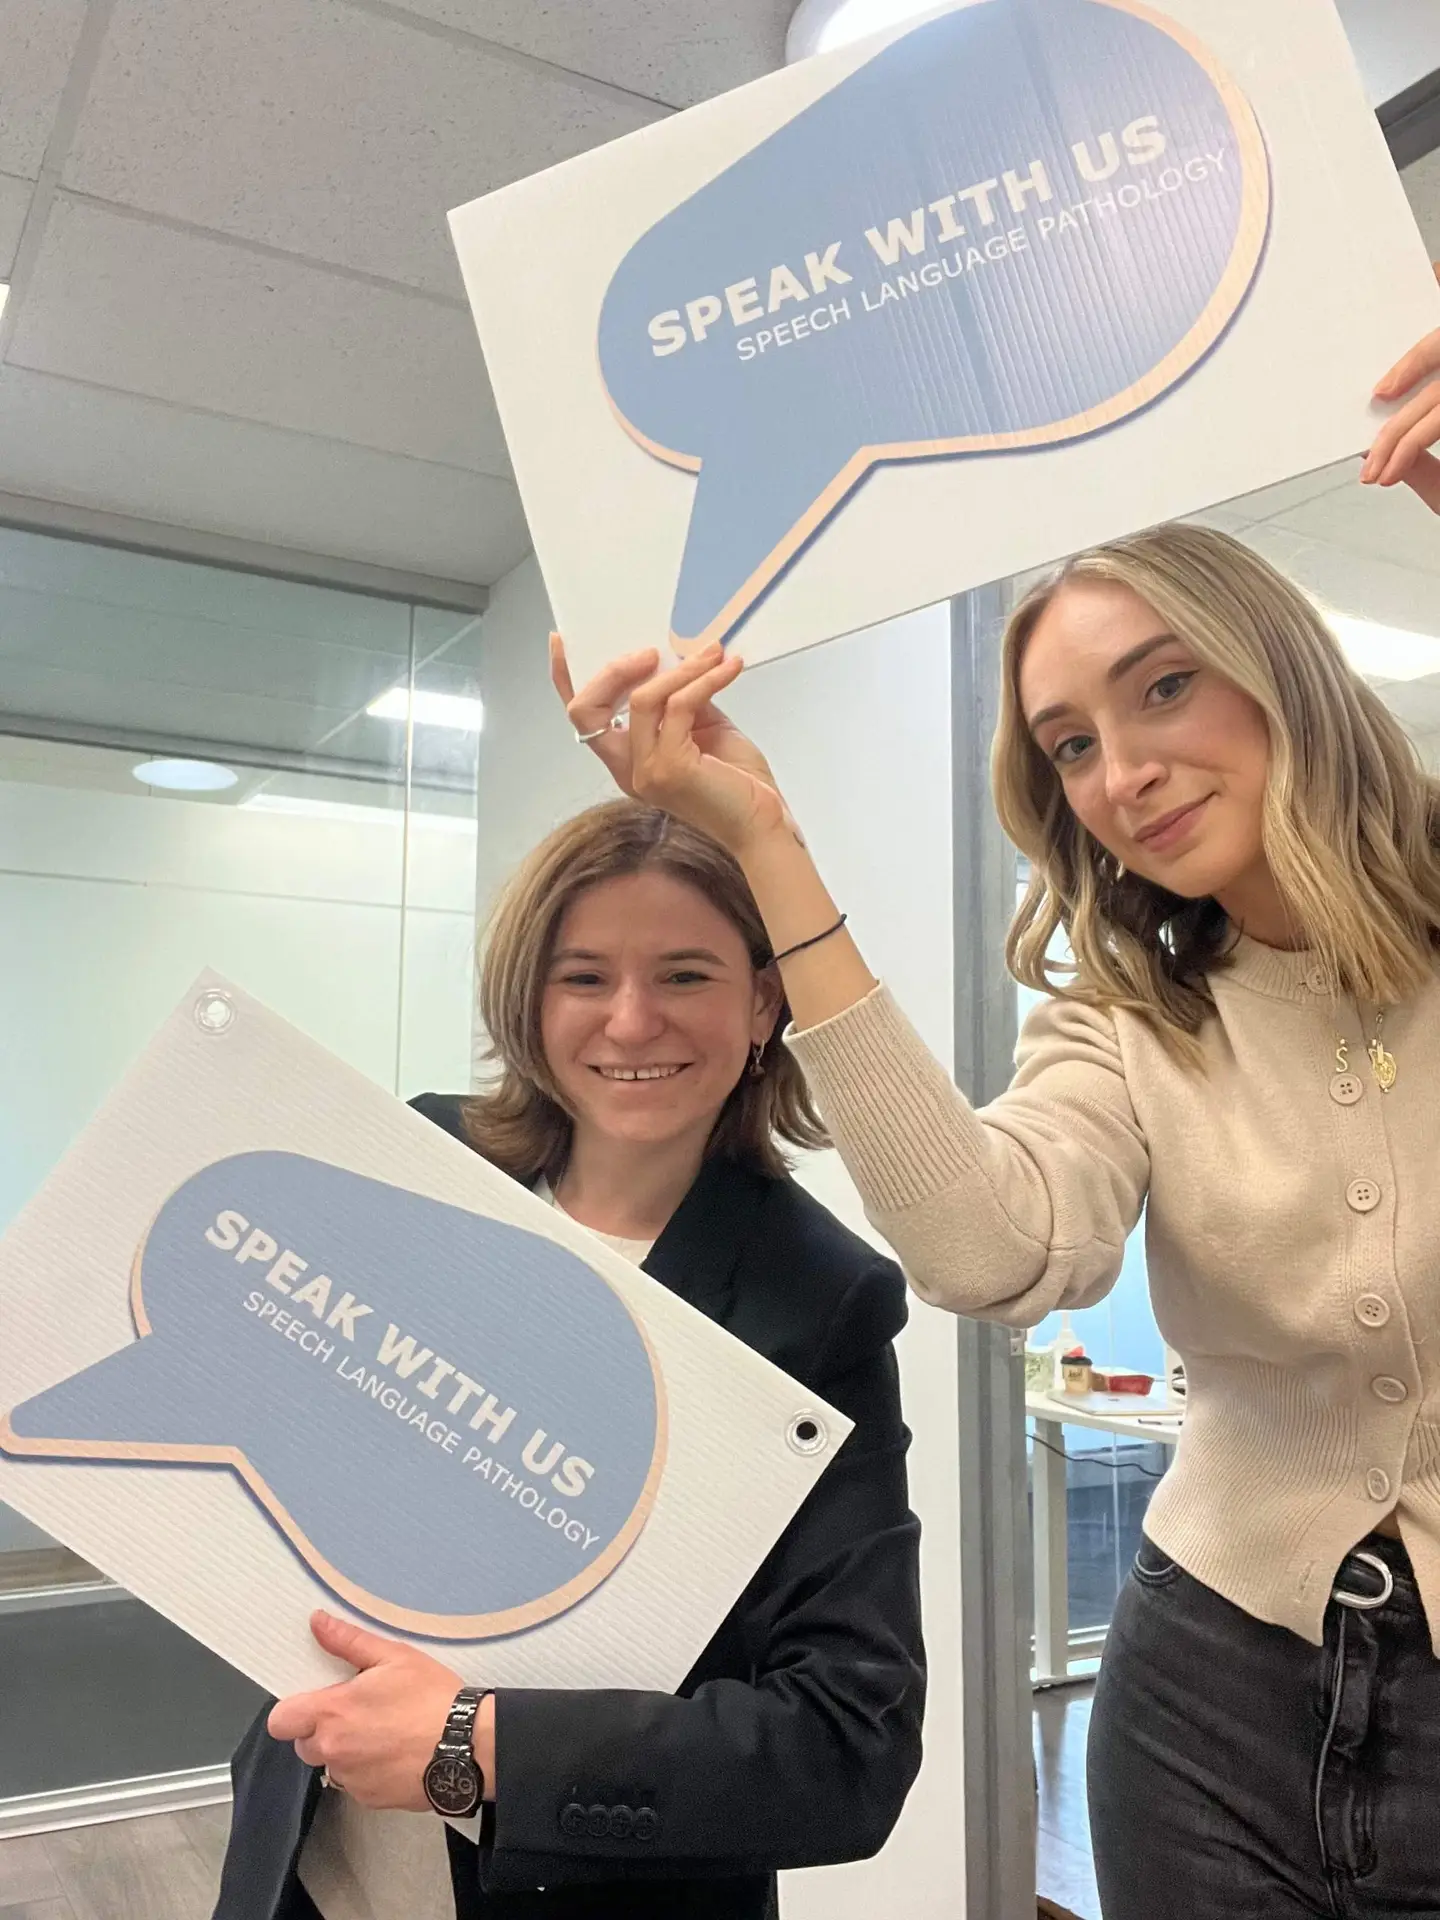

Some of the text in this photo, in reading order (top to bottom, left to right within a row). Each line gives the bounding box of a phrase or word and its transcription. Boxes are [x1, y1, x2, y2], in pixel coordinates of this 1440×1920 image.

[647, 115, 1167, 357] SPEAK WITH US
[735, 148, 1229, 361] SPEECH LANGUAGE PATHOLOGY
[204, 1209, 595, 1497] SPEAK WITH US
[243, 1291, 600, 1552] SPEECH LANGUAGE PATHOLOGY
